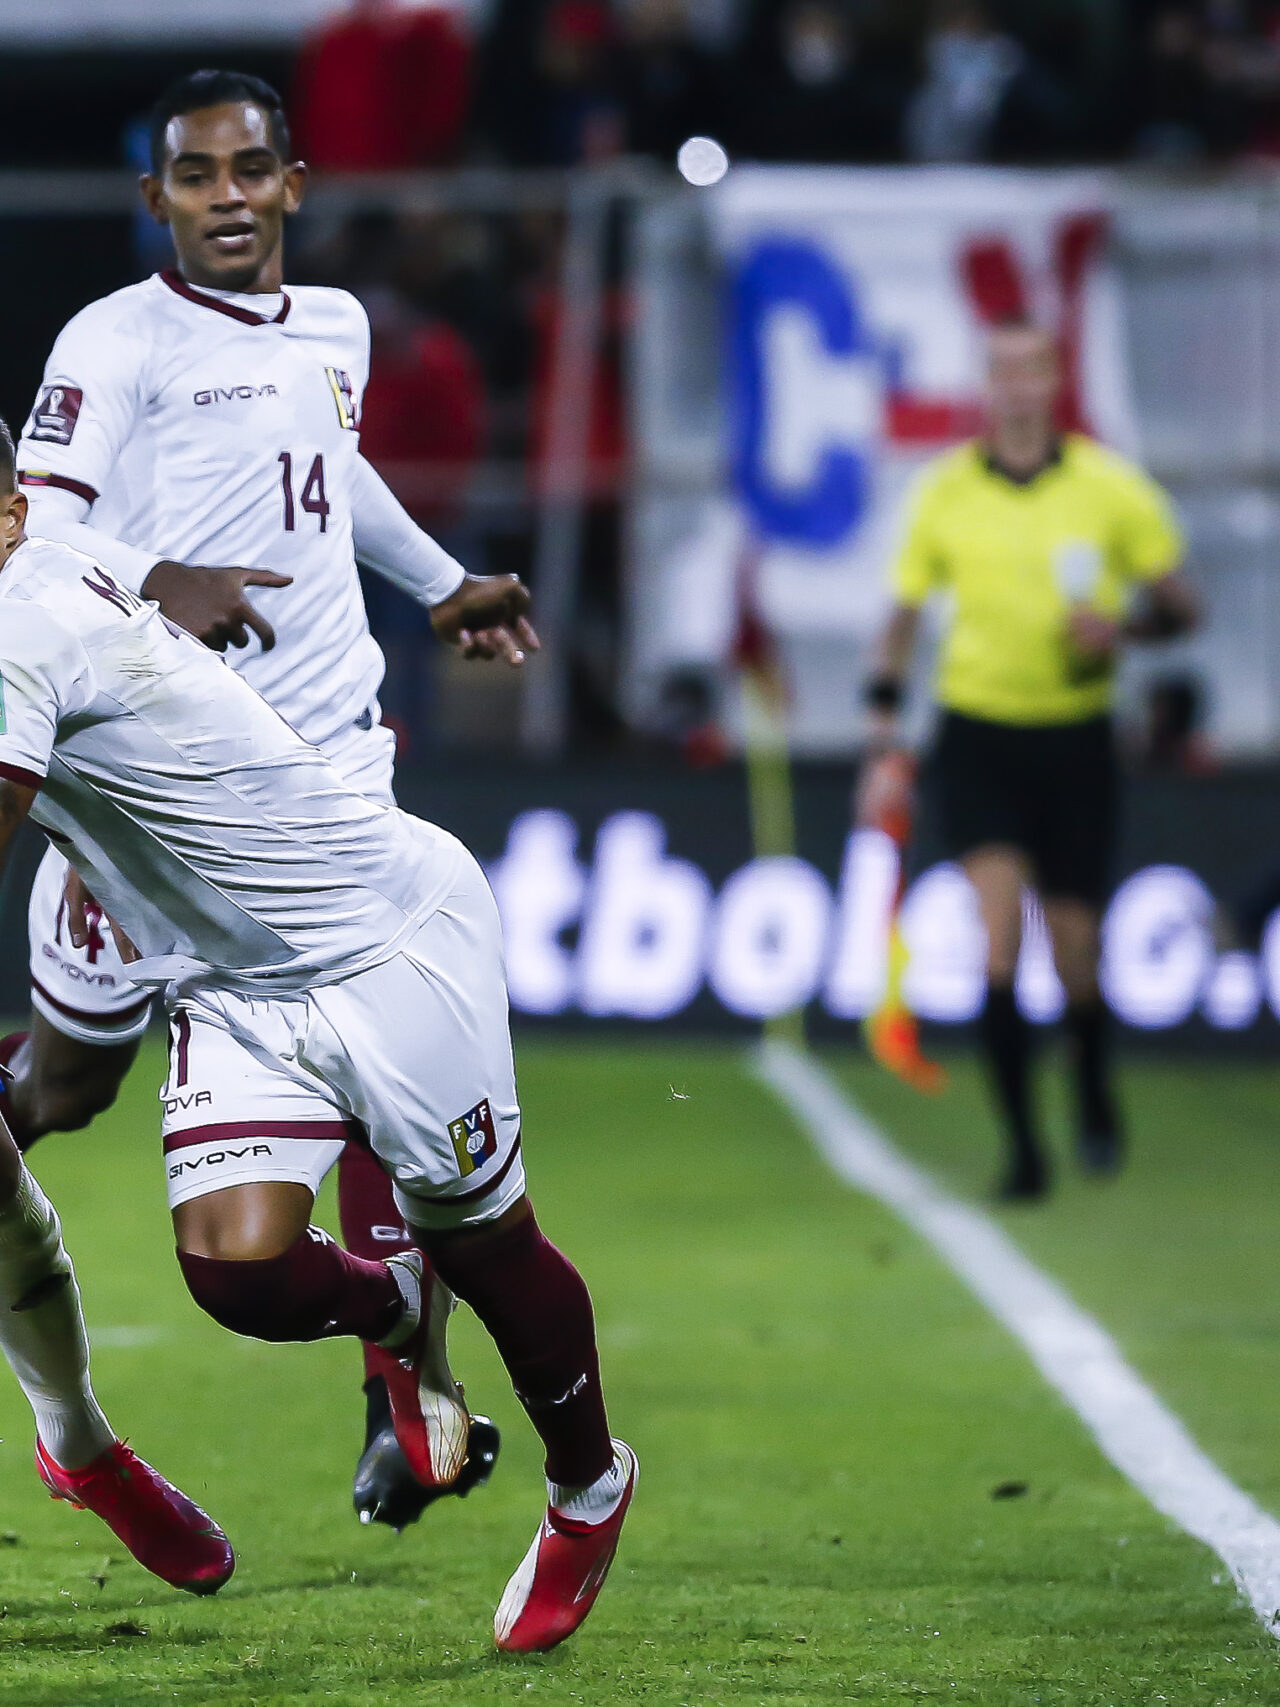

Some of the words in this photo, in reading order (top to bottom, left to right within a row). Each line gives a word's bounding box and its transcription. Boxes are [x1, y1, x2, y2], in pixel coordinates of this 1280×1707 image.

[193, 384, 278, 406] GIVOVA
[277, 451, 330, 533] 14
[169, 1144, 273, 1180] GIVOVA
